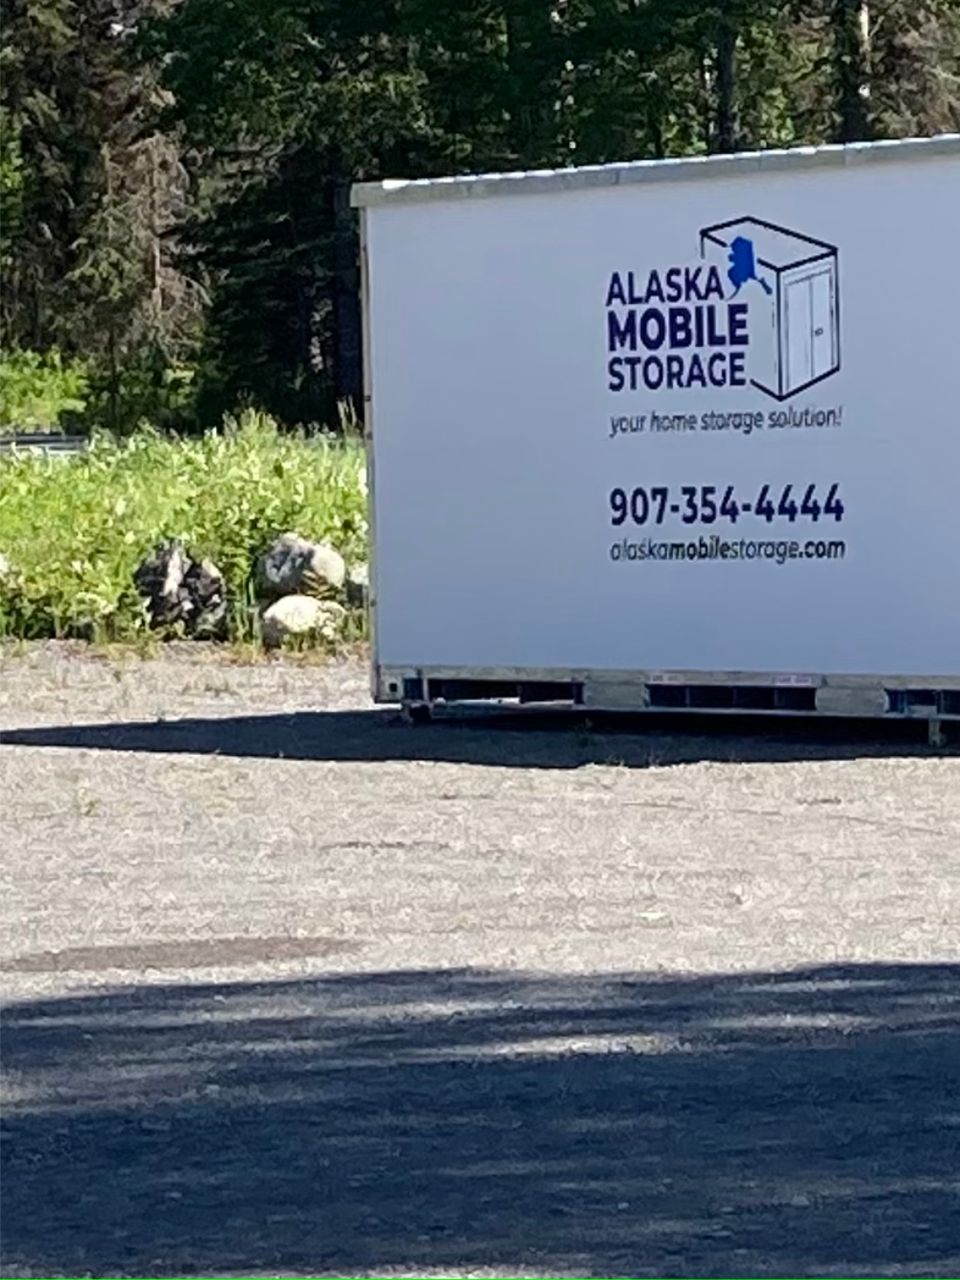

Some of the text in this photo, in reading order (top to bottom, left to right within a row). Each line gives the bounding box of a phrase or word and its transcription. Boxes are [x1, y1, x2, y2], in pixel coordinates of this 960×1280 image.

[606, 266, 725, 306] ALASKA
[608, 304, 749, 351] MOBILE
[608, 352, 747, 392] STORAGE
[609, 405, 842, 437] your home storage solution!
[609, 483, 845, 526] 907-354-4444
[609, 535, 846, 565] alaskamobilestorage.com
